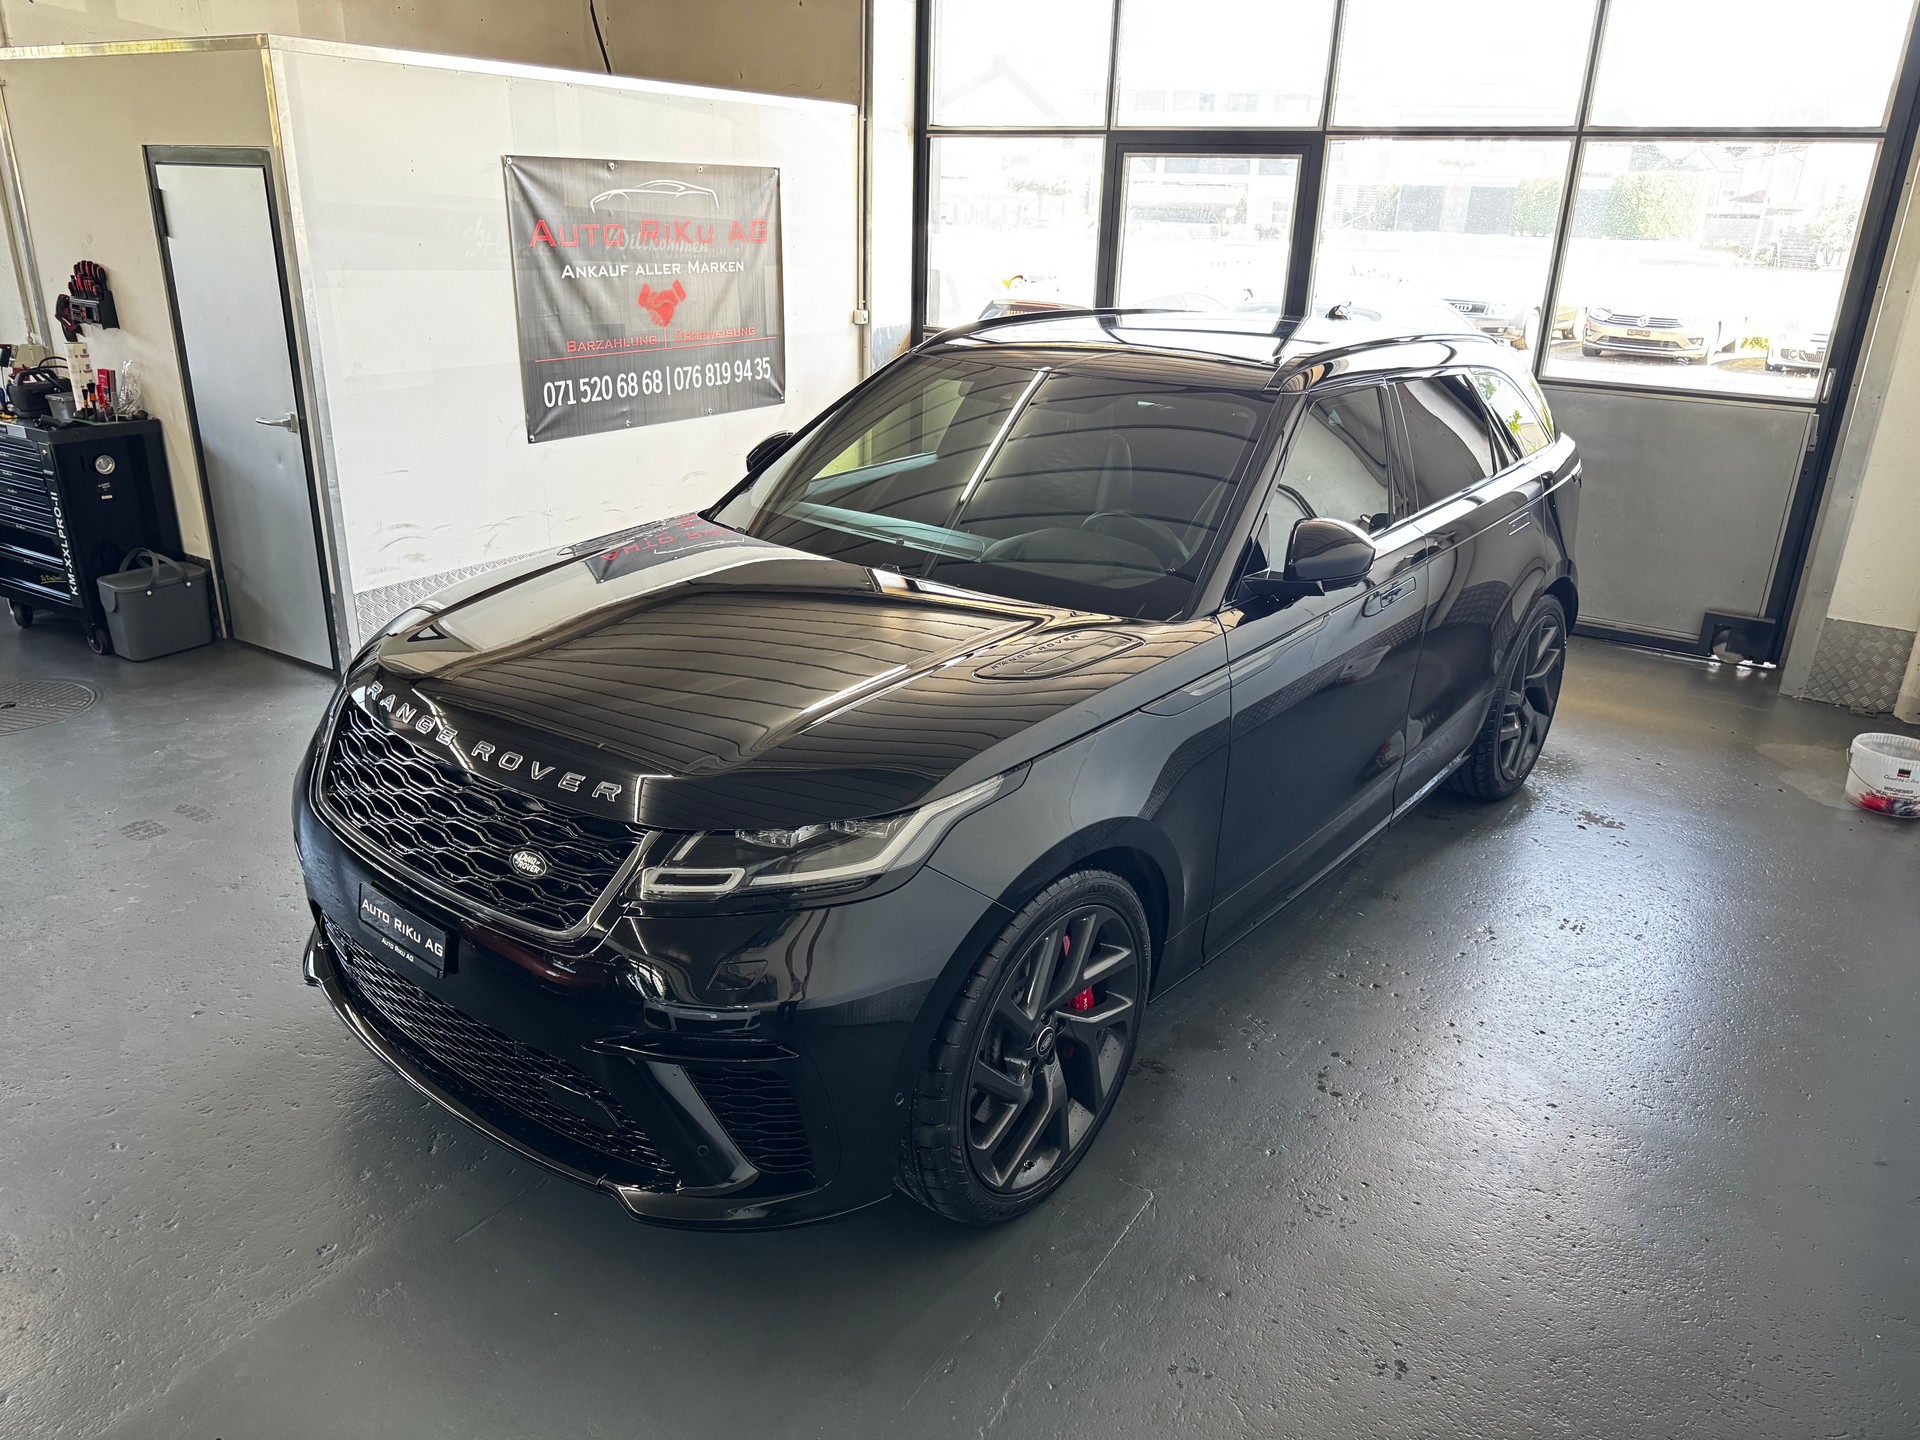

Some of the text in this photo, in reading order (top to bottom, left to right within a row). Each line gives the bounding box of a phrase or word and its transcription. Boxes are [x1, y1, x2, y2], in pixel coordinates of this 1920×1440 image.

[727, 219, 767, 245] AG
[561, 260, 745, 279] ANKAUF ALLER MARKEN
[566, 326, 756, 353] BARZAHLUNG ÜBERWEISUNG
[543, 356, 771, 408] 071 520 68 68 076 819 94 35
[990, 634, 1080, 671] RANGE ROVER
[366, 680, 623, 803] RANGE ROVER
[517, 852, 537, 865] LAND
[517, 860, 541, 874] ROVER
[361, 899, 390, 924] AUTO
[425, 938, 444, 957] AG
[406, 953, 414, 963] AG
